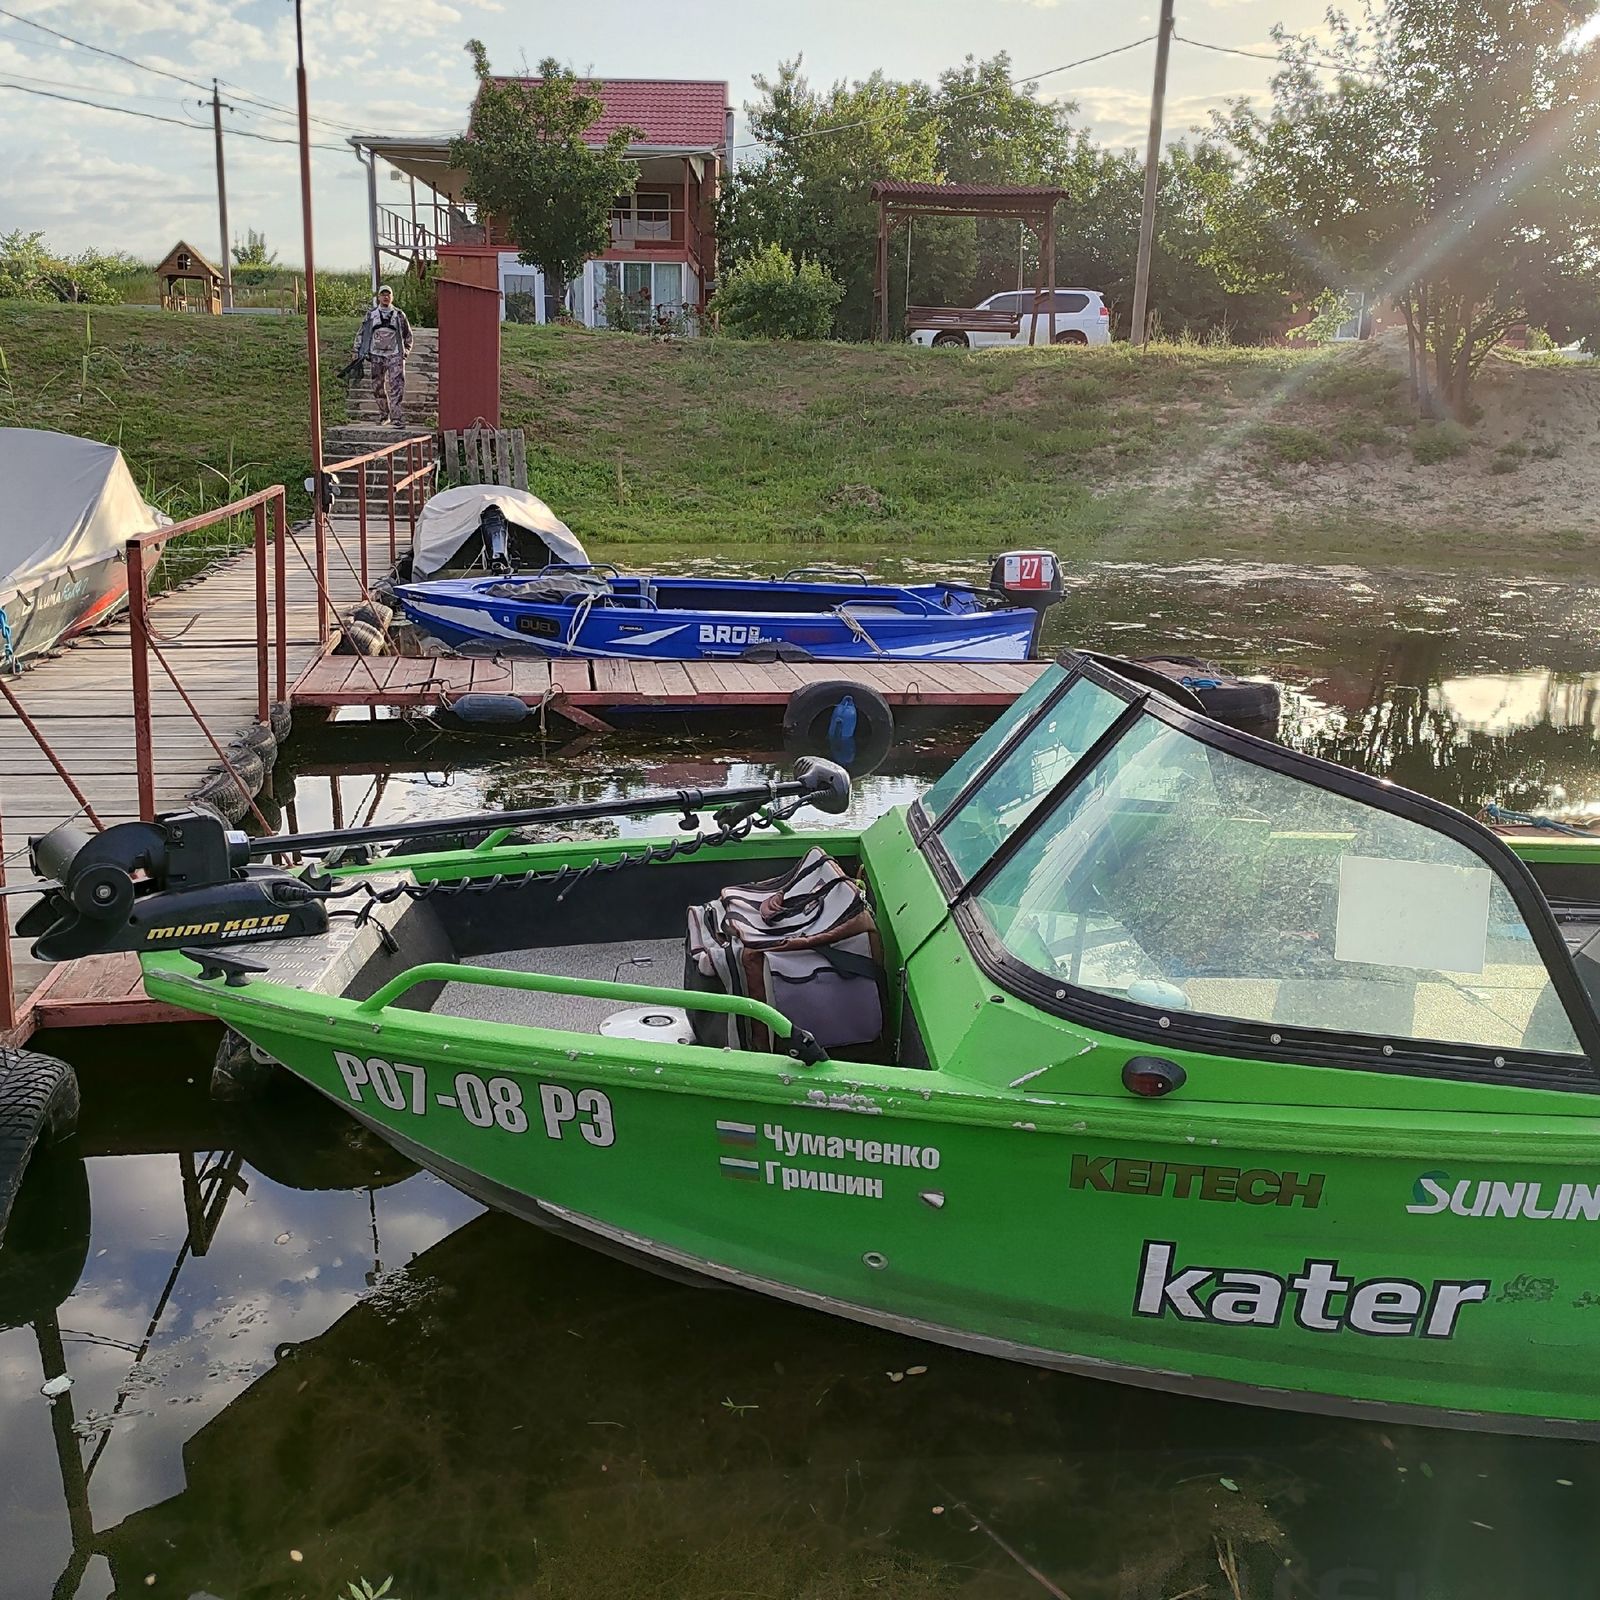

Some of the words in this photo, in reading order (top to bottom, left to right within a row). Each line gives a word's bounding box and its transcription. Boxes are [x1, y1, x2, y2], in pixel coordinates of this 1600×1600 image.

[1022, 558, 1039, 579] 27
[520, 617, 556, 634] DUEL
[699, 624, 747, 644] BRO
[223, 913, 290, 932] KOTA
[539, 1083, 616, 1148] РЭ
[763, 1123, 940, 1170] Чумаченко
[765, 1160, 883, 1199] Гришин
[1069, 1154, 1326, 1209] KEITECH
[1132, 1239, 1492, 1340] kater
